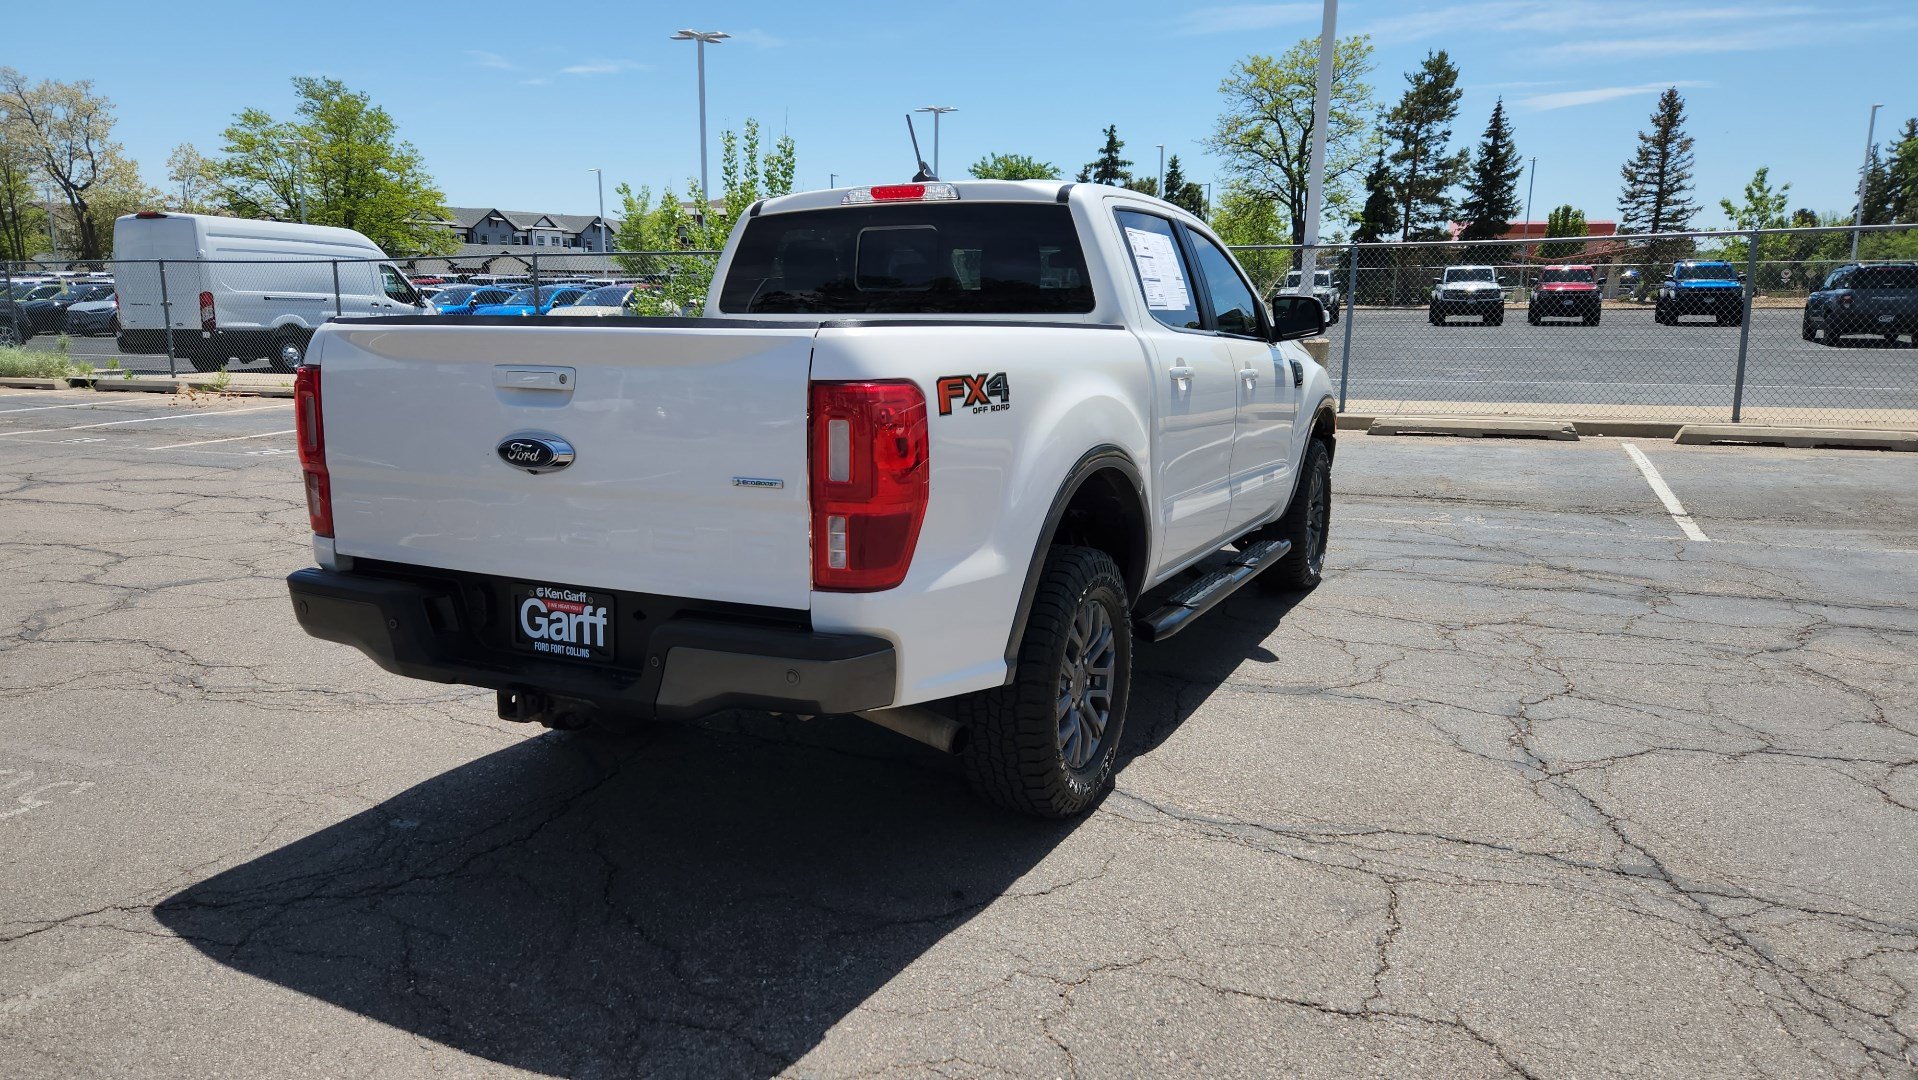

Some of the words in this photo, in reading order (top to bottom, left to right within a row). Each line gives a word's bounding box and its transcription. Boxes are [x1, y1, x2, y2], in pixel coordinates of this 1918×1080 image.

[936, 372, 1010, 416] FX4
[972, 406, 988, 415] OFF
[990, 403, 1010, 412] ROAD
[507, 442, 541, 462] Ford
[544, 587, 563, 600] Ken
[563, 589, 587, 603] Garff
[520, 597, 607, 647] Garff
[534, 641, 550, 652] FORD
[550, 643, 565, 654] FORT
[565, 645, 590, 658] COLLINS
